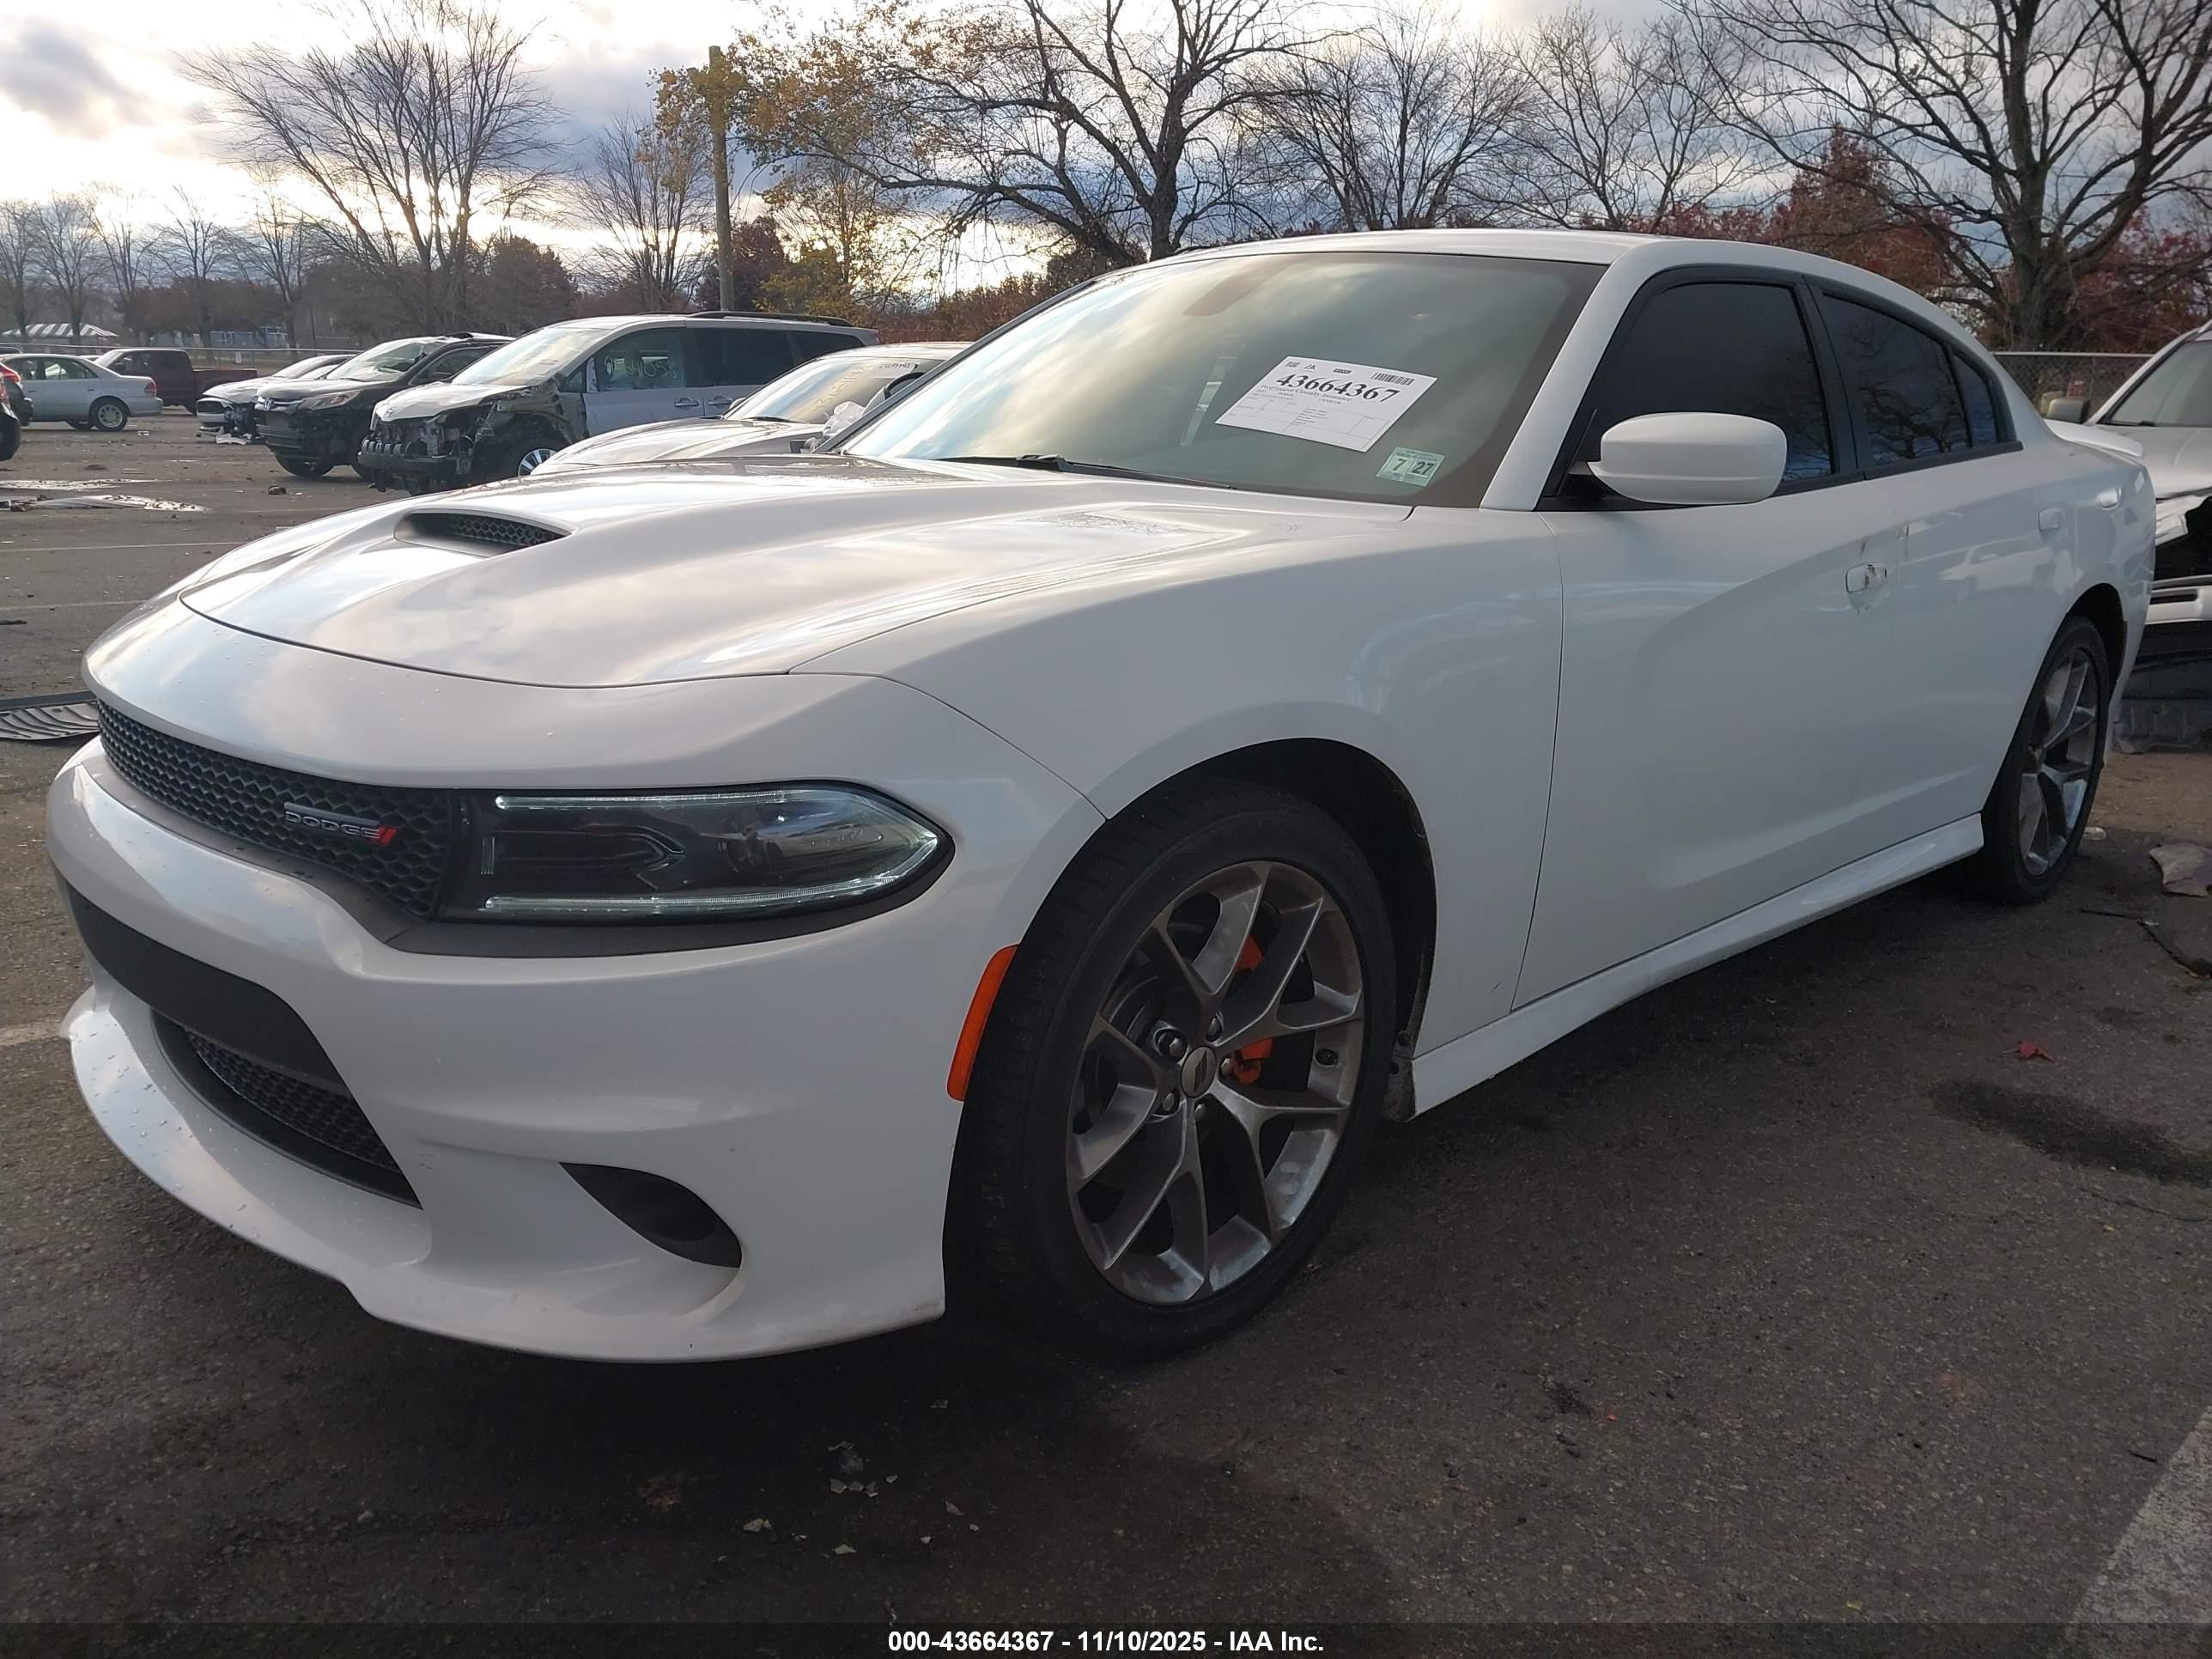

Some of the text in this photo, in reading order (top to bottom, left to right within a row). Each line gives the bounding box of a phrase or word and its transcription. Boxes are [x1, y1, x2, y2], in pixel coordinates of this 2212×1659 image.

[1276, 374, 1401, 403] 43664367
[1392, 458, 1435, 476] 7 27
[284, 811, 380, 840] DODGE
